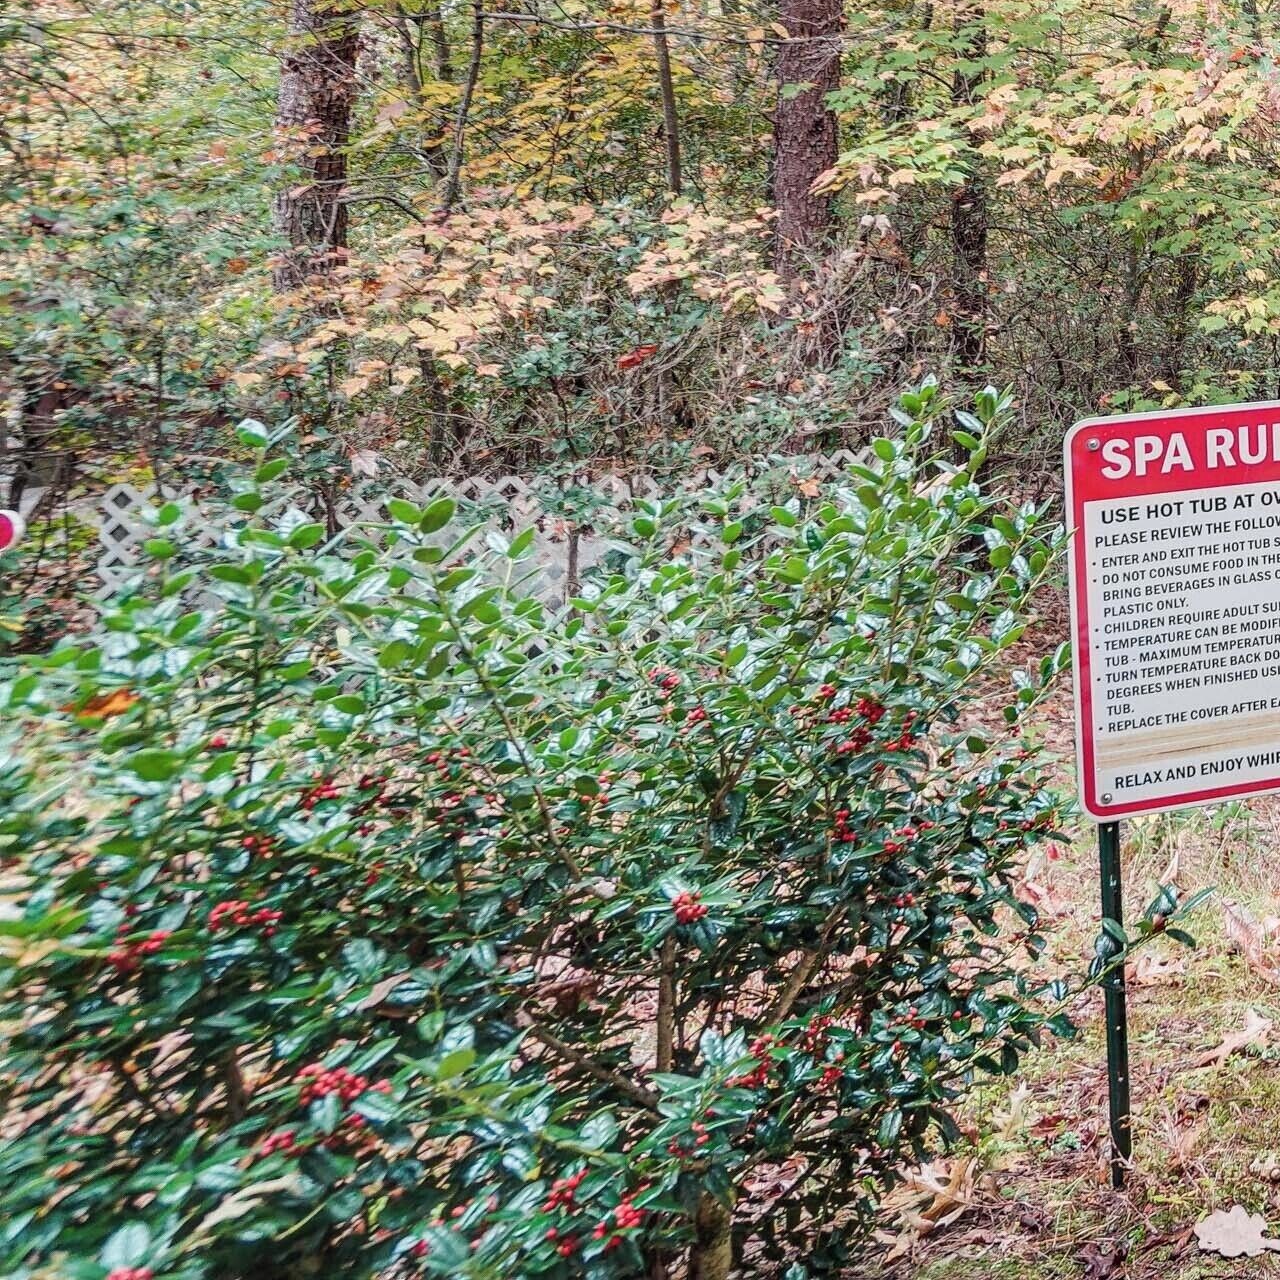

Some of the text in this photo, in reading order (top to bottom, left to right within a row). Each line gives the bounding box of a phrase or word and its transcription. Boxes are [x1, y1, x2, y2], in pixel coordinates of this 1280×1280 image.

[1101, 432, 1194, 480] SPA
[1101, 506, 1140, 524] USE
[1146, 501, 1184, 519] HOT
[1189, 497, 1227, 514] TUB
[1233, 493, 1255, 510] AT
[1095, 530, 1148, 548] PLEASE
[1151, 524, 1203, 541] REVIEW
[1205, 521, 1231, 535] THE
[1102, 554, 1139, 568] ENTER
[1142, 550, 1167, 563] AND
[1171, 546, 1195, 559] EXIT
[1197, 544, 1220, 556] THE
[1223, 540, 1245, 553] HOT
[1247, 538, 1271, 550] TUB
[1102, 573, 1119, 585] DO
[1123, 569, 1146, 582] NOT
[1149, 561, 1210, 579] CONSUME
[1212, 558, 1244, 571] FOOD
[1247, 556, 1259, 567] IN
[1103, 587, 1141, 602] BRING
[1145, 577, 1215, 596] BEVERAGES
[1218, 575, 1230, 587] IN
[1233, 570, 1271, 585] GLASS
[1104, 597, 1189, 618] PLASTIC ONLY.
[1104, 616, 1165, 635] CHILDREN
[1168, 609, 1220, 626] REQUIRE
[1222, 604, 1260, 619] ADULT
[1104, 629, 1192, 651] TEMPERATURE
[1194, 626, 1218, 639] CAN
[1222, 623, 1237, 635] BE
[1104, 655, 1129, 668] TUB
[1139, 644, 1201, 663] MAXIMUM
[1105, 669, 1138, 684] TURN
[1140, 657, 1227, 679] TEMPERATURE
[1230, 652, 1261, 666] BACK
[1107, 682, 1162, 700] DEGREES
[1165, 676, 1200, 691] WHEN
[1204, 669, 1258, 686] FINISHED
[1106, 703, 1134, 716] TUB.
[1108, 714, 1162, 733] REPLACE
[1164, 711, 1187, 724] THE
[1190, 705, 1228, 720] COVER
[1231, 699, 1267, 714] AFTER
[1115, 770, 1163, 790] RELAX
[1165, 765, 1196, 782] AND
[1200, 757, 1244, 776] ENJOY
